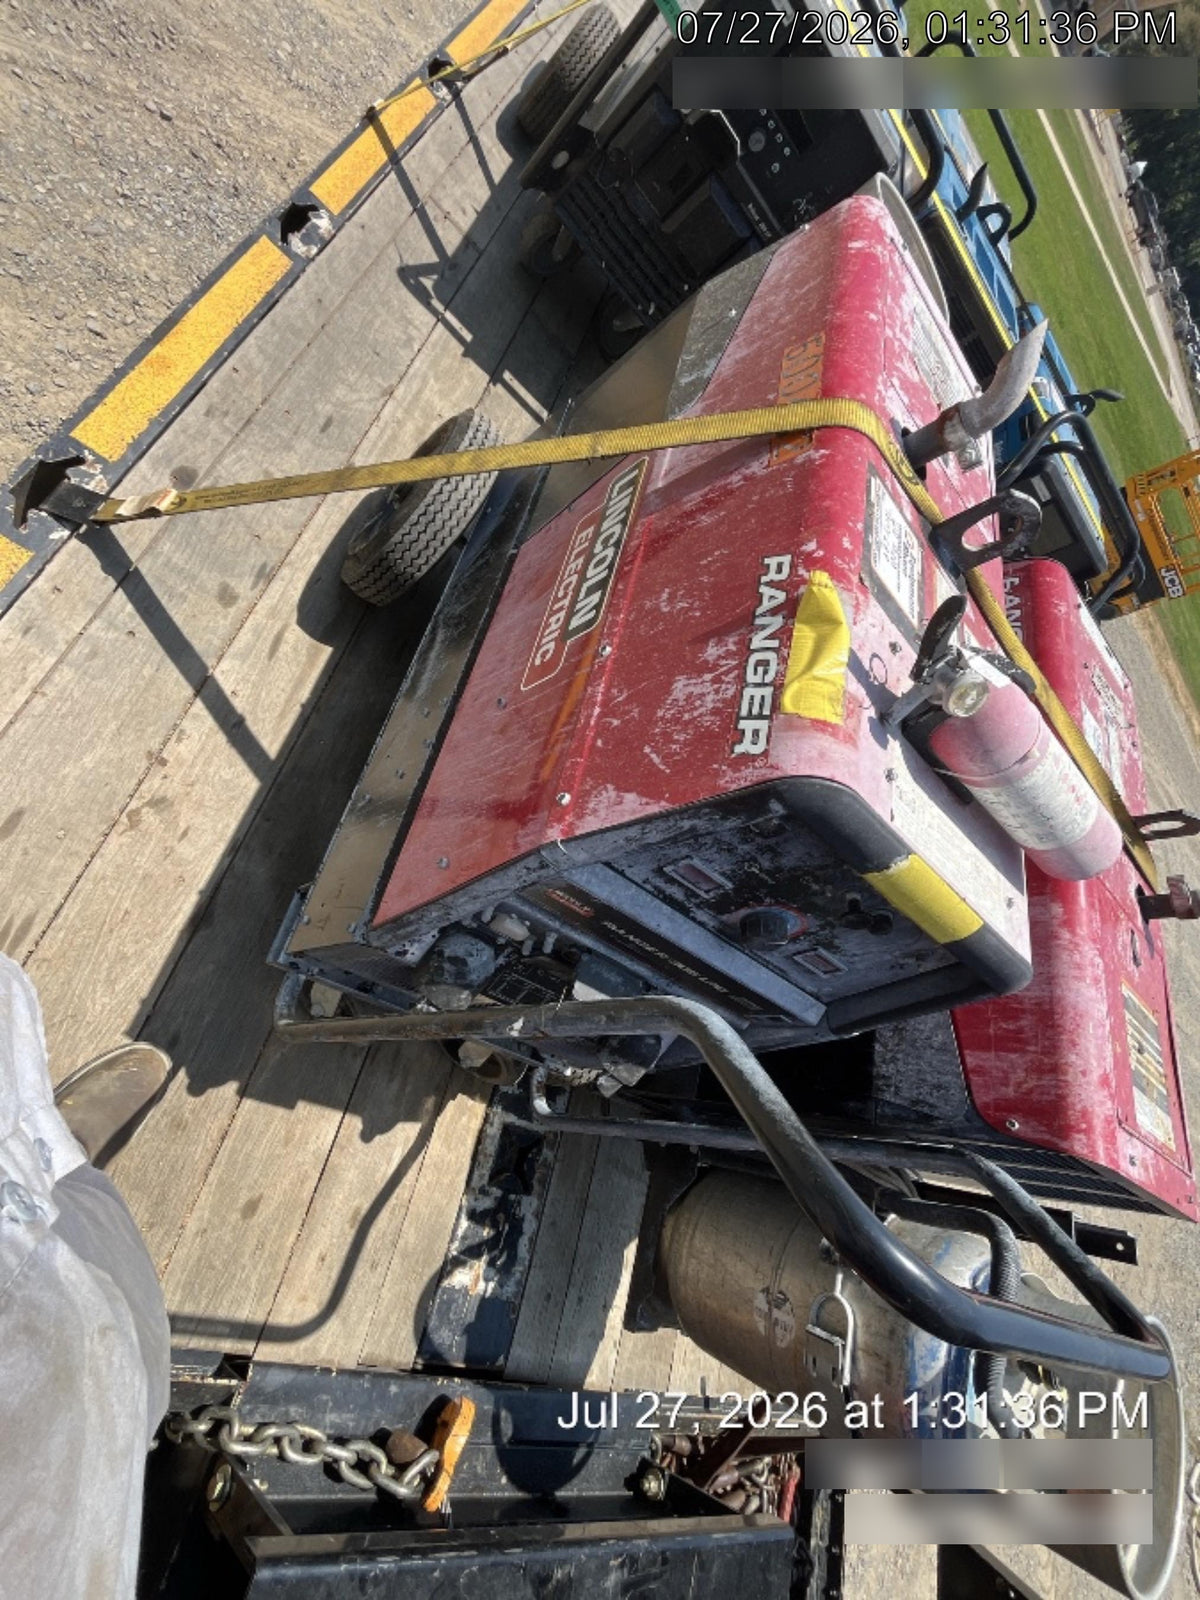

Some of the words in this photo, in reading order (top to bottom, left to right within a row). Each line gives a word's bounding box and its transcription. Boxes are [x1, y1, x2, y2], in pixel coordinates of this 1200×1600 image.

[534, 524, 595, 666] ELECTRIC
[568, 468, 640, 631] LINCOLN
[1160, 567, 1184, 599] JCB
[733, 553, 792, 755] RANGER
